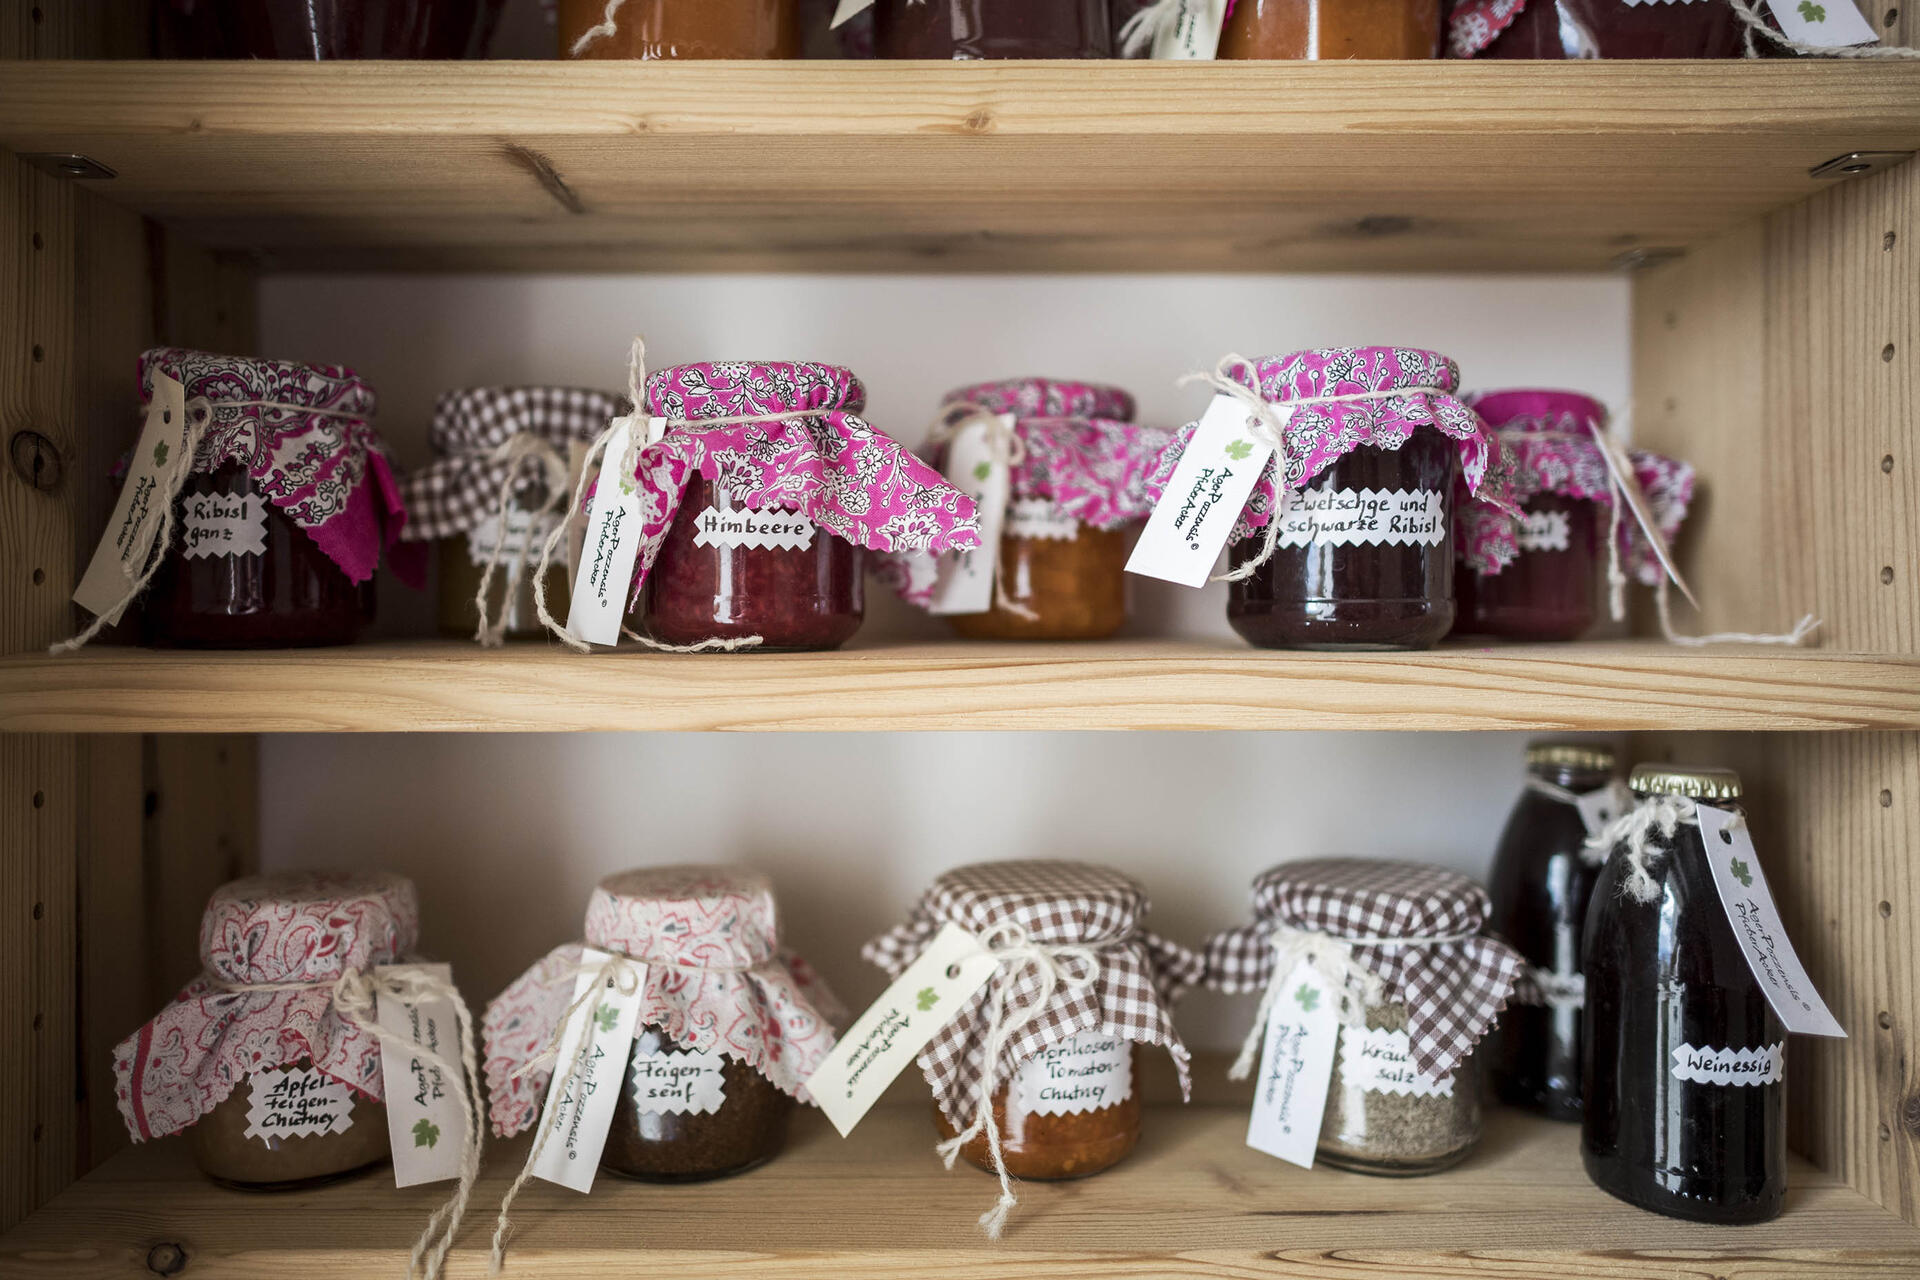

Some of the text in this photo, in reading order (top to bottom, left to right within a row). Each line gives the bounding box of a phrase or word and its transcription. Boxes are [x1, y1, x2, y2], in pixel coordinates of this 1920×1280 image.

[194, 497, 248, 520] Ribisl
[1290, 492, 1428, 521] Zwetschge und
[704, 515, 804, 535] Himbeere
[1286, 514, 1436, 541] schwarze Ribisl
[189, 526, 233, 548] ganz
[1361, 1040, 1407, 1062] Kräu
[638, 1060, 713, 1088] Feigen-
[1375, 1068, 1414, 1084] salz
[1687, 1053, 1771, 1077] Weinessig
[273, 1074, 335, 1098] Apfel-
[647, 1081, 695, 1103] senf
[1040, 1084, 1107, 1102] Chutney
[261, 1112, 339, 1131] Chutney
